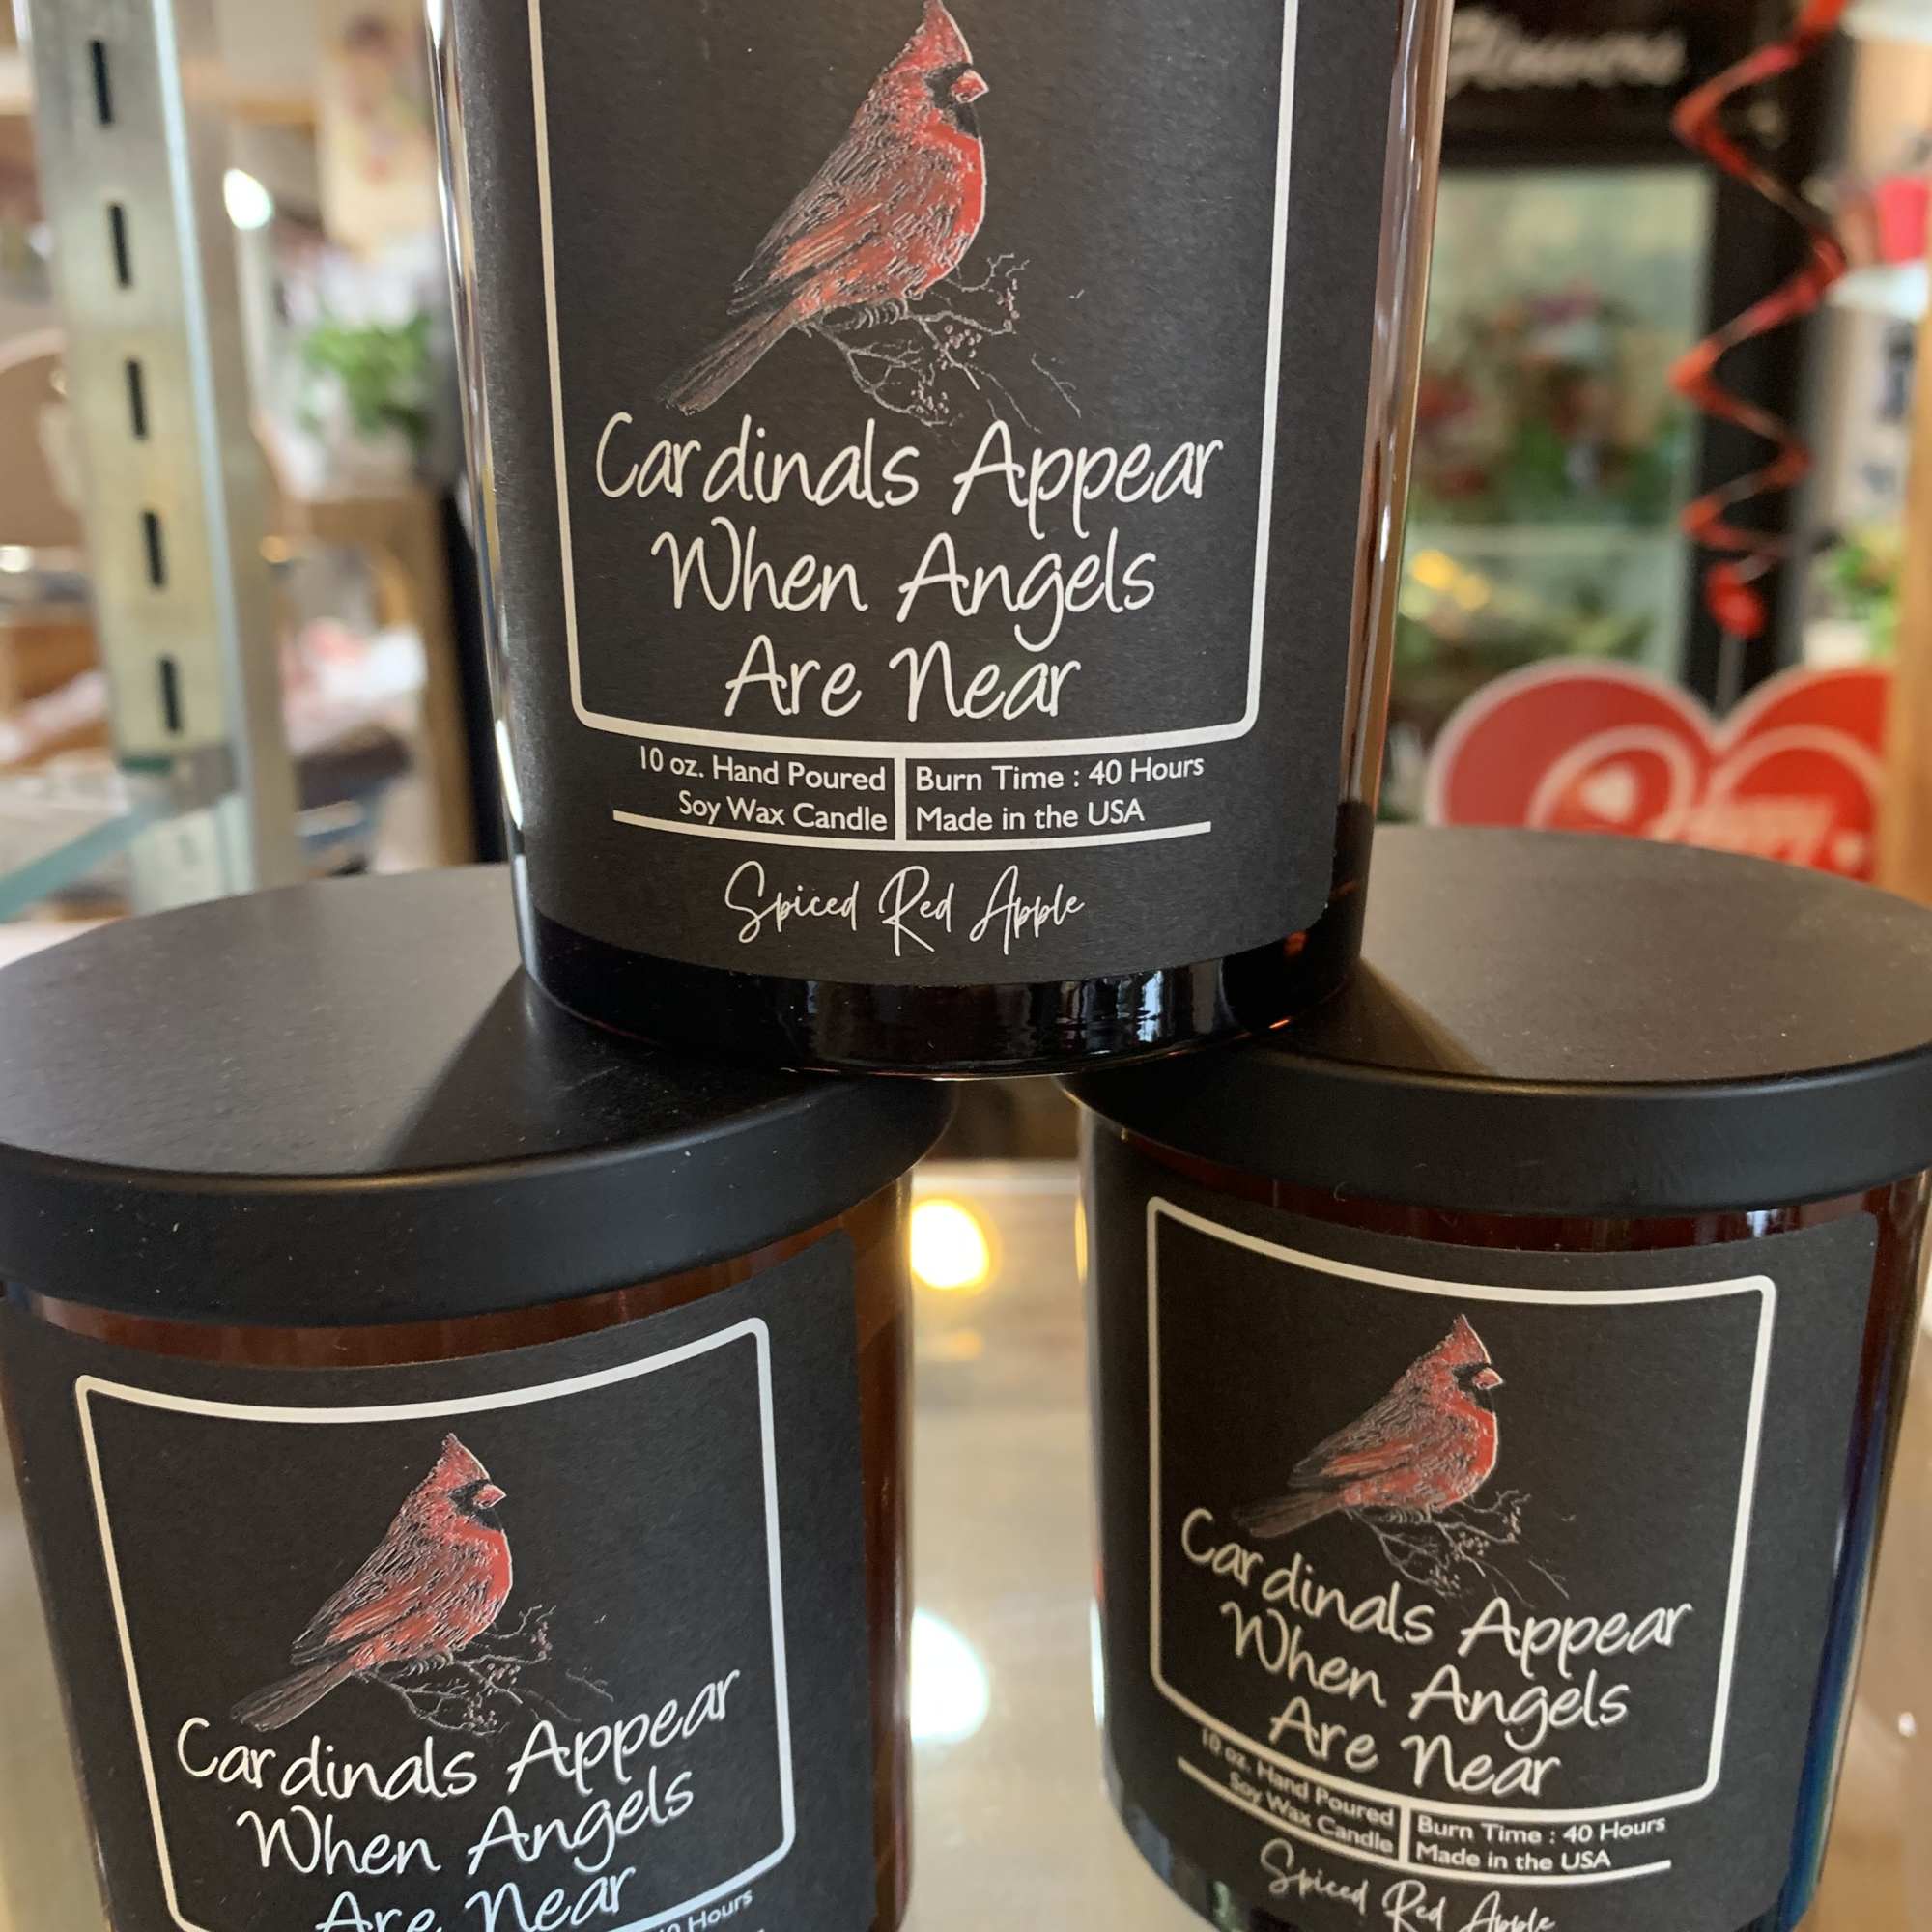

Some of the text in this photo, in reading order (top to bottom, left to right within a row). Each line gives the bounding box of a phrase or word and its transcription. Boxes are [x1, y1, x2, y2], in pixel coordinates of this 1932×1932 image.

[595, 412, 1224, 538] Cardinals Appear
[651, 517, 1156, 650] When Angels
[724, 634, 1081, 722] Are Near
[640, 745, 886, 791] 10 oz. Hand Poured
[679, 790, 888, 831] Soy Wax Candle
[916, 756, 1205, 791] Burn Time : 40 Hours
[916, 798, 1145, 831] Made in the USA
[724, 861, 1085, 956] Spiced Red Apple
[1181, 1508, 1693, 1677] Cardinals Appear
[1221, 1602, 1630, 1751] When Angels
[177, 1669, 740, 1801] Cardinals Appear
[1269, 1697, 1560, 1796] Are Near
[236, 1765, 695, 1876] When Angels
[1230, 1771, 1393, 1854] Soy Wax Candle
[1257, 1760, 1309, 1800] Hand
[1315, 1787, 1394, 1828] Poured
[1417, 1815, 1666, 1844] Burn Time : 40 Hours
[1261, 1838, 1369, 1916] Spiced
[1381, 1880, 1446, 1932] Red
[1415, 1841, 1612, 1871] Made in the USA
[464, 1867, 636, 1932] Near
[688, 1889, 753, 1932] Hours
